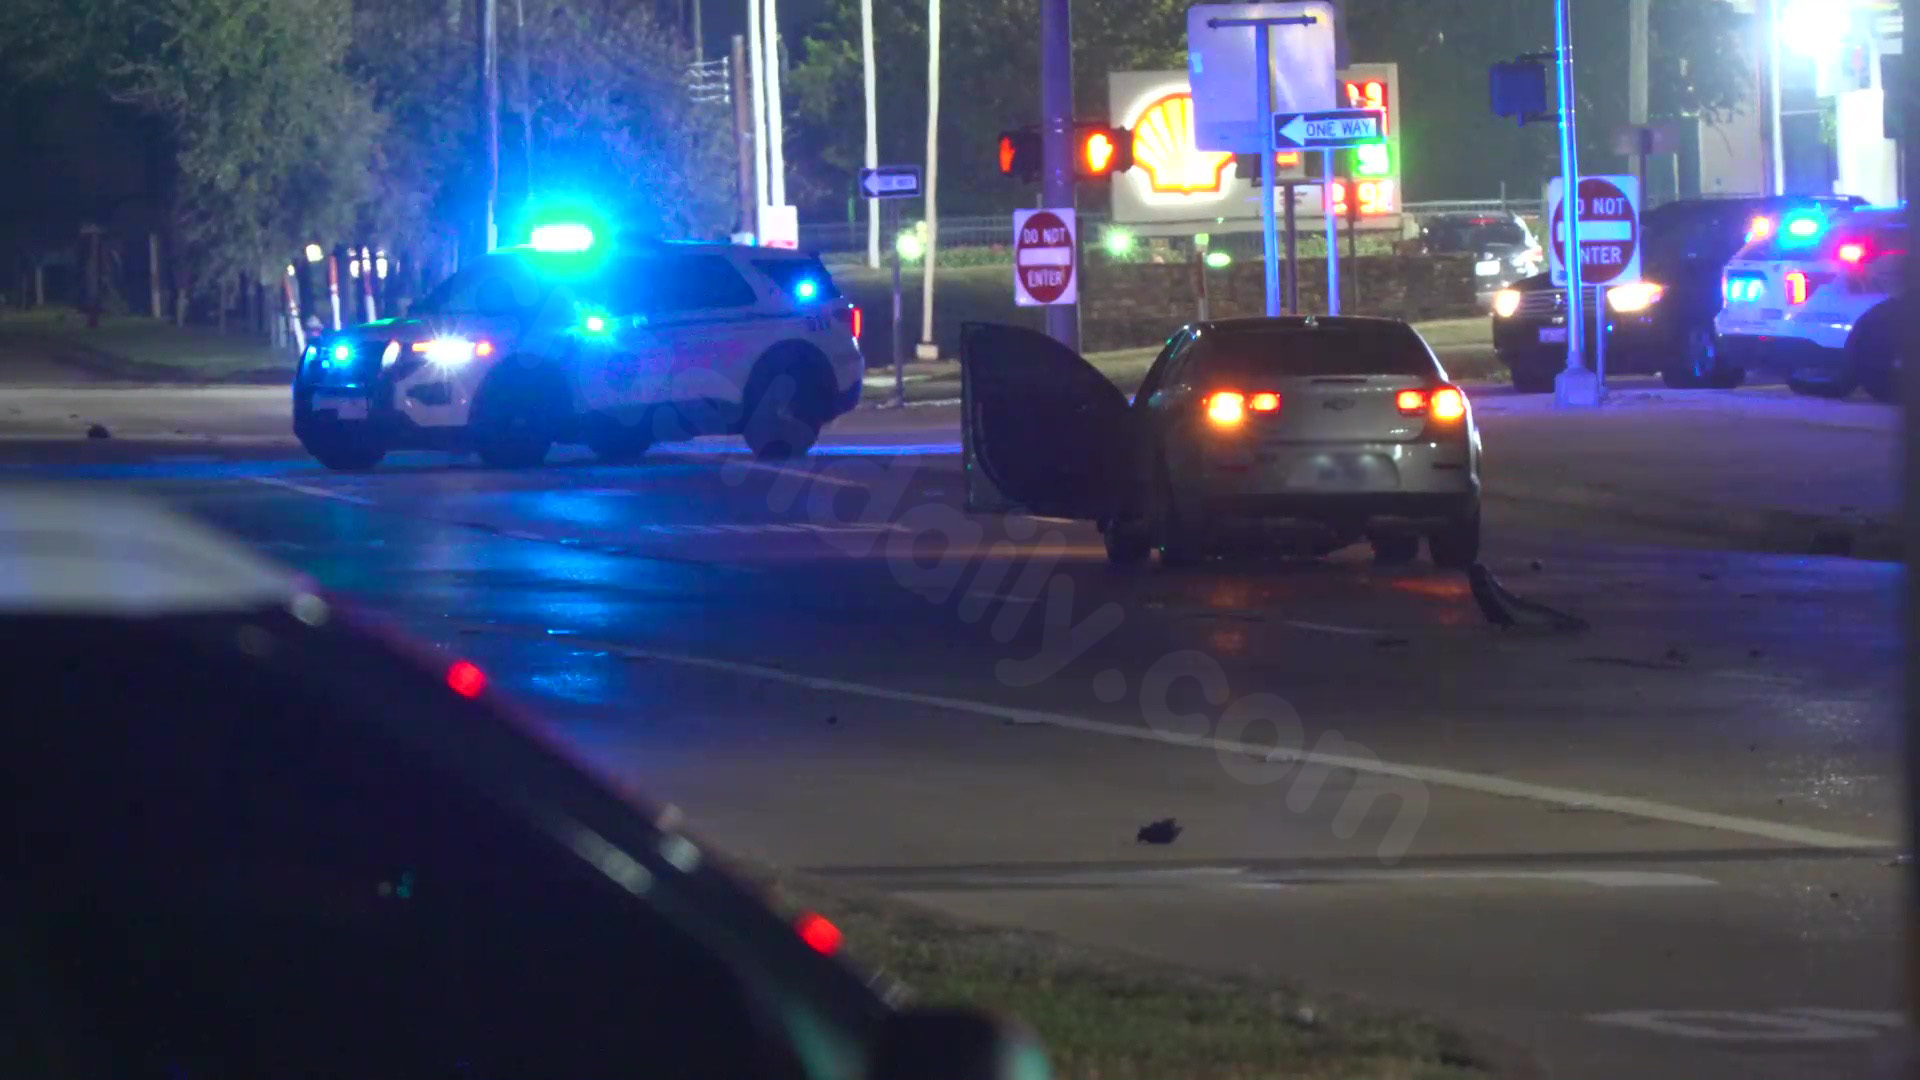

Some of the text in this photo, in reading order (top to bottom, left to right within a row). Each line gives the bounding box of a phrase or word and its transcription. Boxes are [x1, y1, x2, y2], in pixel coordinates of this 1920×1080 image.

[1306, 119, 1371, 137] ONE WAY
[1593, 197, 1625, 215] NOT
[1023, 227, 1066, 244] DO NOT
[1580, 245, 1622, 265] NTER
[1027, 269, 1062, 288] ENTER
